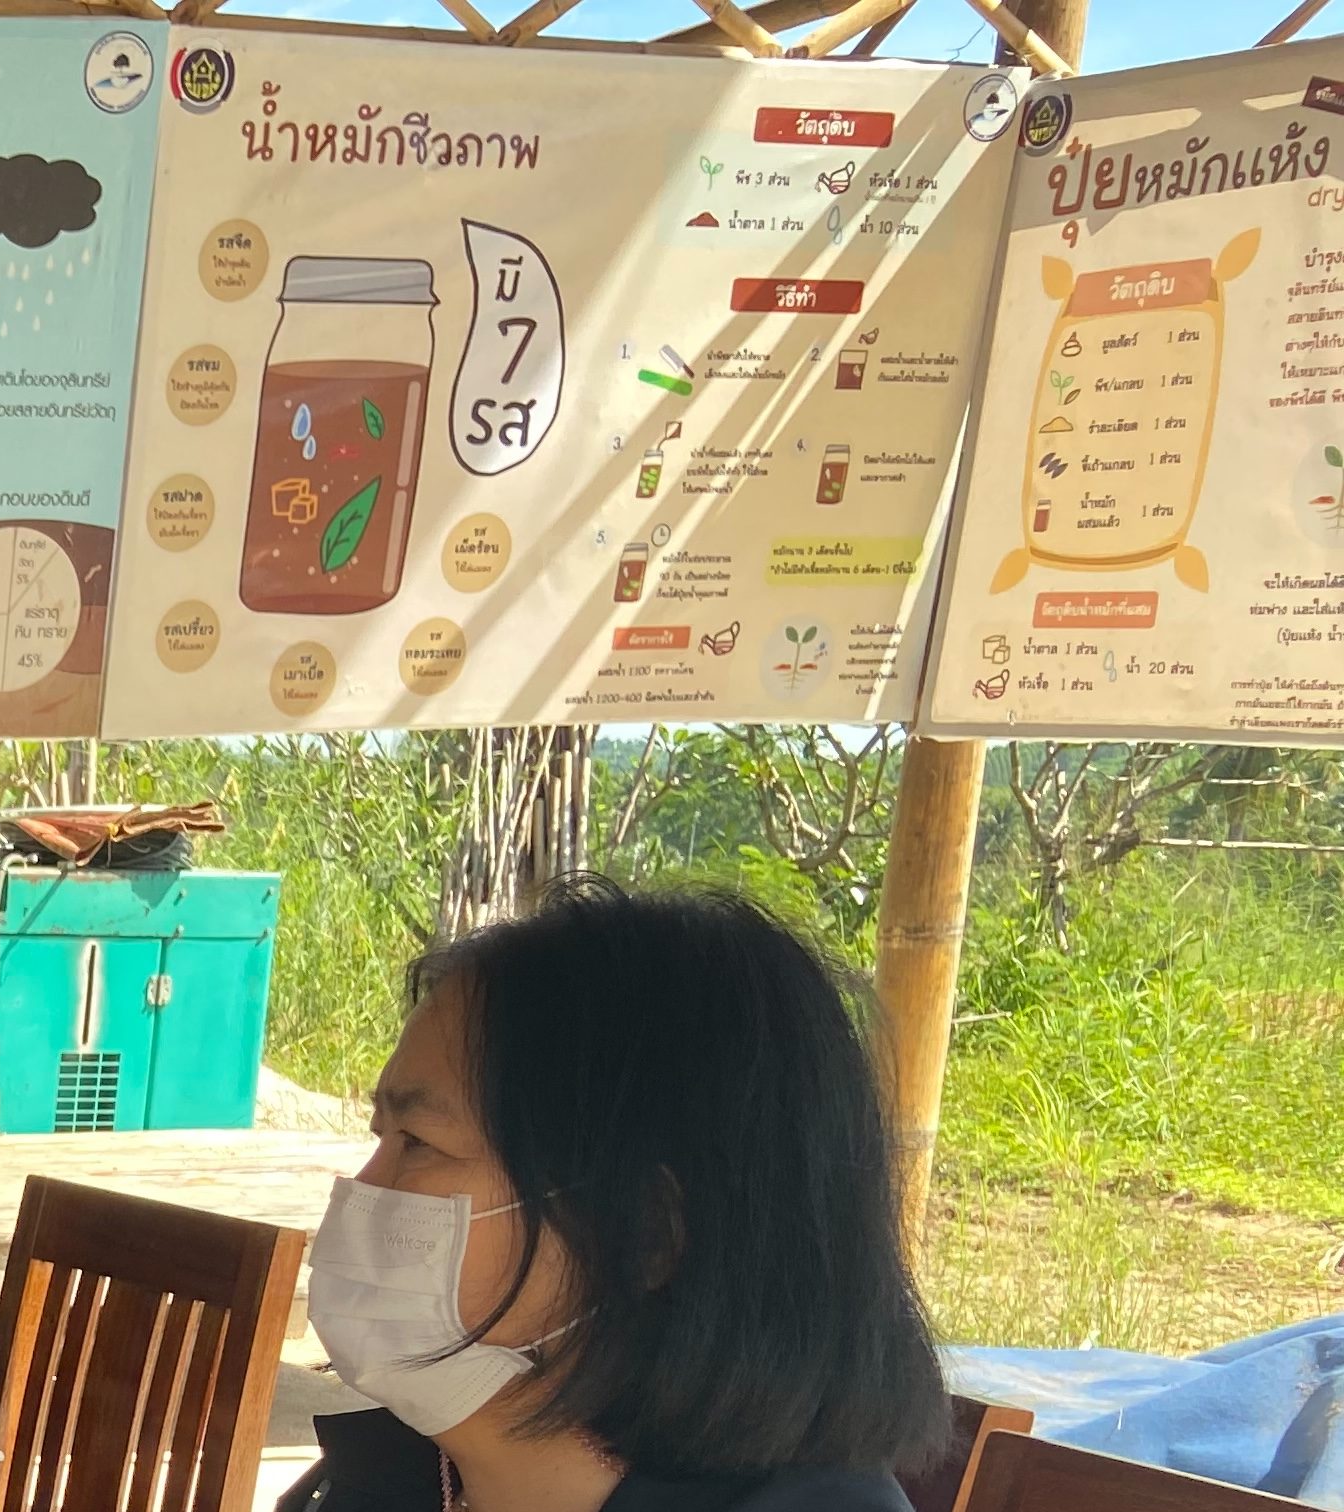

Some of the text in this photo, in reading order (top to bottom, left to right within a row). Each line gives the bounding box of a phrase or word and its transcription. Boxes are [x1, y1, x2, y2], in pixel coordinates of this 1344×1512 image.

[242, 80, 540, 169] น้ำหมักชีวภาพ
[796, 111, 856, 145] วัตถุดิบ
[755, 173, 764, 185] 3
[768, 172, 790, 186] ส่วน
[906, 177, 912, 189] 1
[916, 175, 937, 189] ส่วน
[1048, 121, 1330, 248] ปุ๋ยหมักแห้ง
[729, 210, 919, 236] น้ำตาล 1 ส่วน น้ำ 10 ส่วน
[495, 255, 524, 302] มี
[775, 284, 817, 308] วิธีทำ
[1109, 270, 1176, 308] วัตถุดิบ
[1167, 331, 1173, 343] 1
[1178, 329, 1200, 343] ส่วน
[498, 317, 538, 385] 7
[1161, 375, 1166, 387] 1
[1171, 373, 1193, 387] ส่วน
[465, 397, 538, 448] รส
[1155, 418, 1160, 430] 1
[1165, 416, 1186, 429] ส่วน
[1150, 453, 1154, 466] 1
[1159, 451, 1181, 465] ส่วน
[1142, 505, 1147, 517] 1
[1152, 504, 1174, 517] ส่วน
[1024, 637, 1098, 655] น้ำตาล 1 ส่วน
[17, 653, 44, 668] 45%
[1126, 656, 1194, 675] น้ำ 20 ส่วน
[1061, 678, 1065, 690] 1
[1071, 677, 1093, 690] ส่วน
